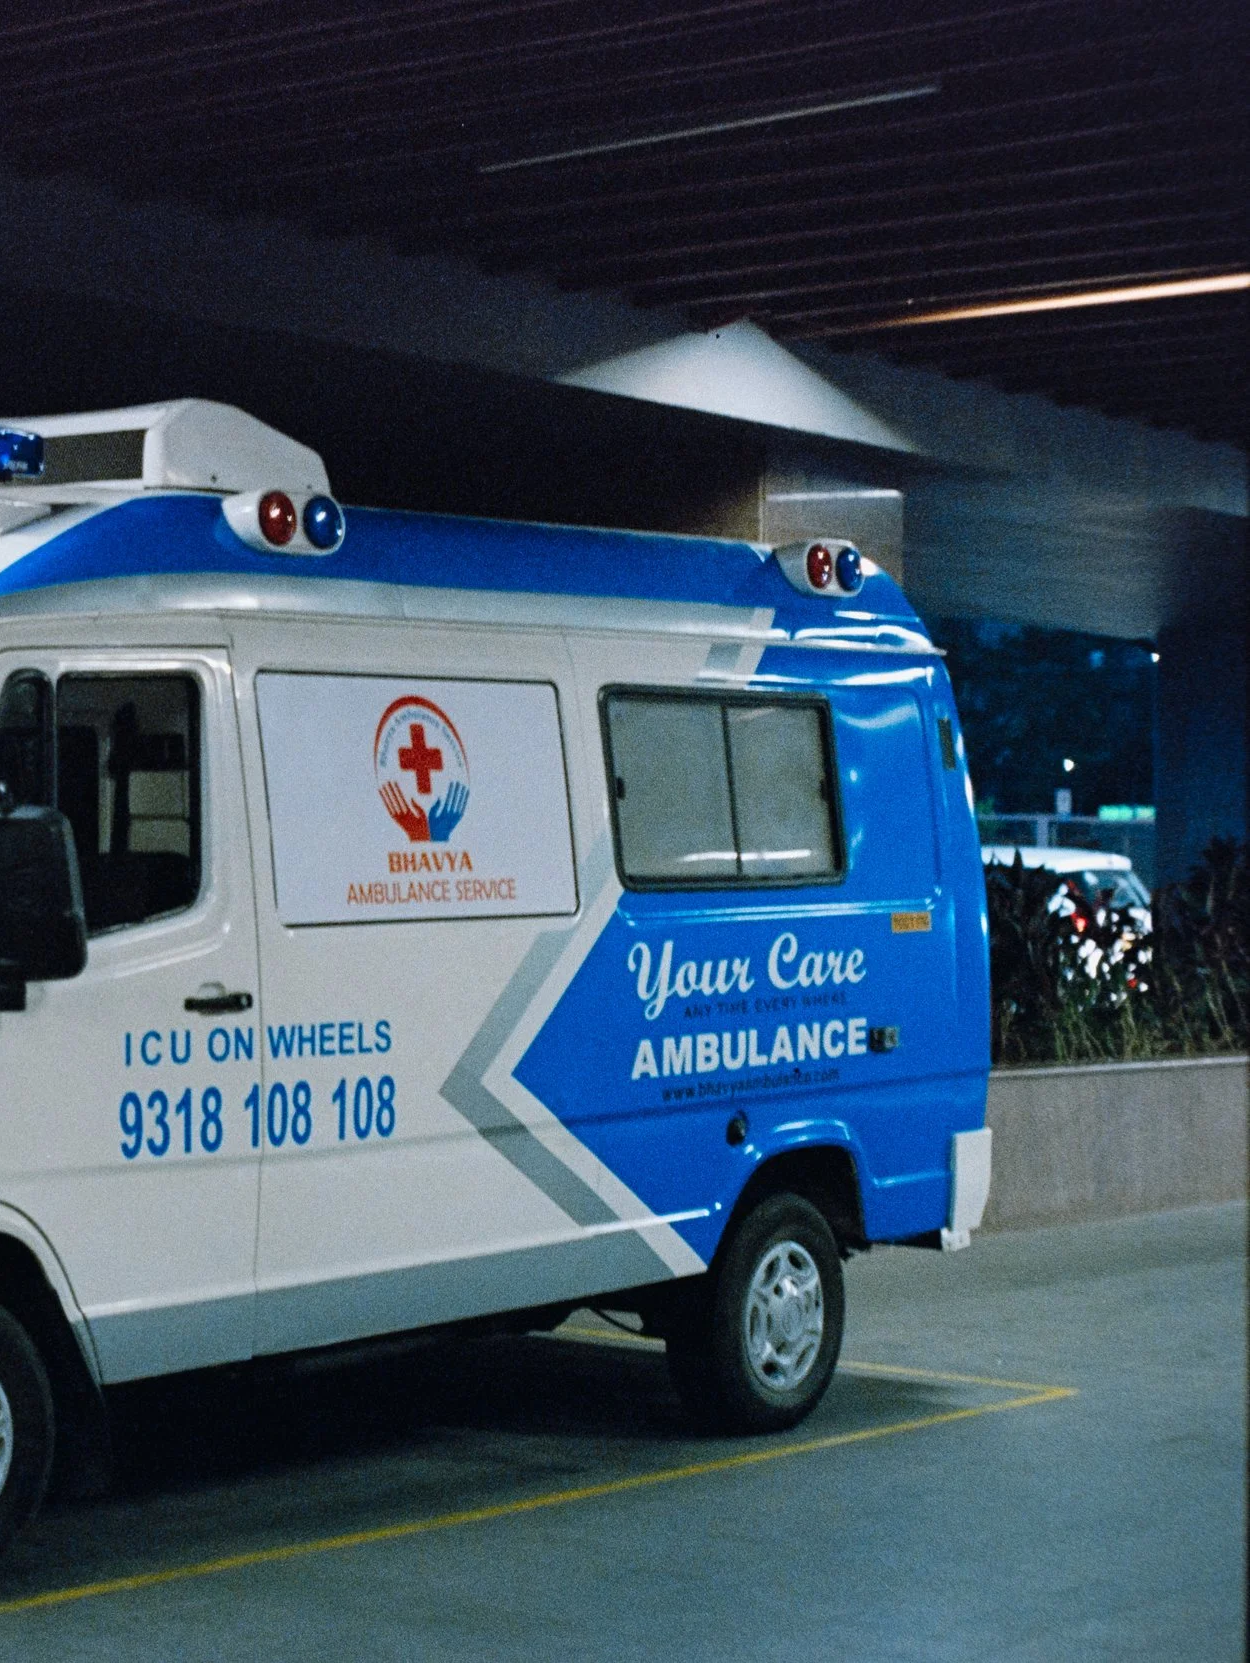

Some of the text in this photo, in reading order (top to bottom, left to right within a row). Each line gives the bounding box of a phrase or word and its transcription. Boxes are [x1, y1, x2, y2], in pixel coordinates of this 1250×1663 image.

[388, 851, 473, 873] BHAVYA
[347, 878, 516, 905] AMBULANCE SERVICE
[627, 932, 866, 1020] Your Care
[207, 1027, 253, 1062] ON
[267, 1020, 392, 1058] WHEELS
[631, 1017, 867, 1080] AMBULANCE
[119, 1075, 396, 1160] 9318 108 108
